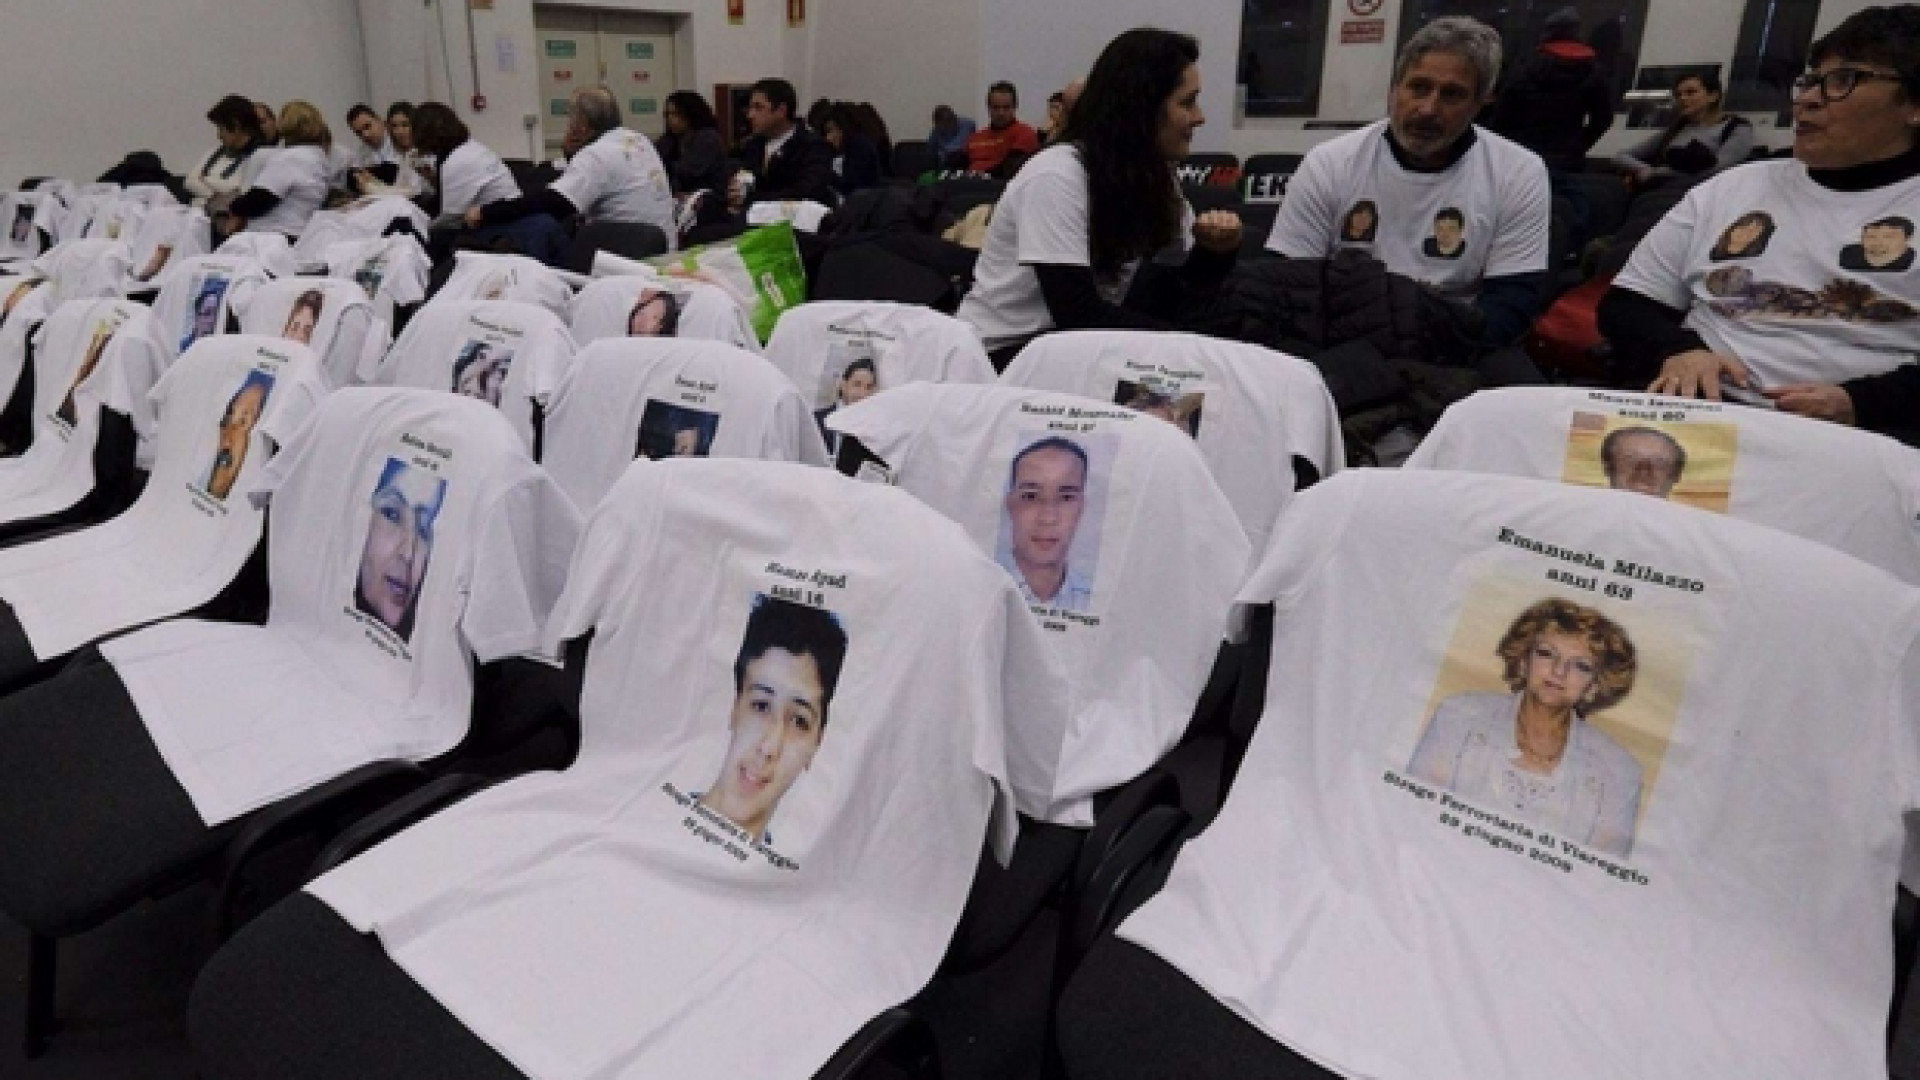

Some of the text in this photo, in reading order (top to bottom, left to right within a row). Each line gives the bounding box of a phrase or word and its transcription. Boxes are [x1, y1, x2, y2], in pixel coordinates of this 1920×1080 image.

[1497, 526, 1704, 592] Emanuela Milazzo
[1545, 568, 1634, 600] anni 63
[1382, 770, 1649, 885] Strage Ferroviaria di Viareggio
[1462, 823, 1524, 855] giugno
